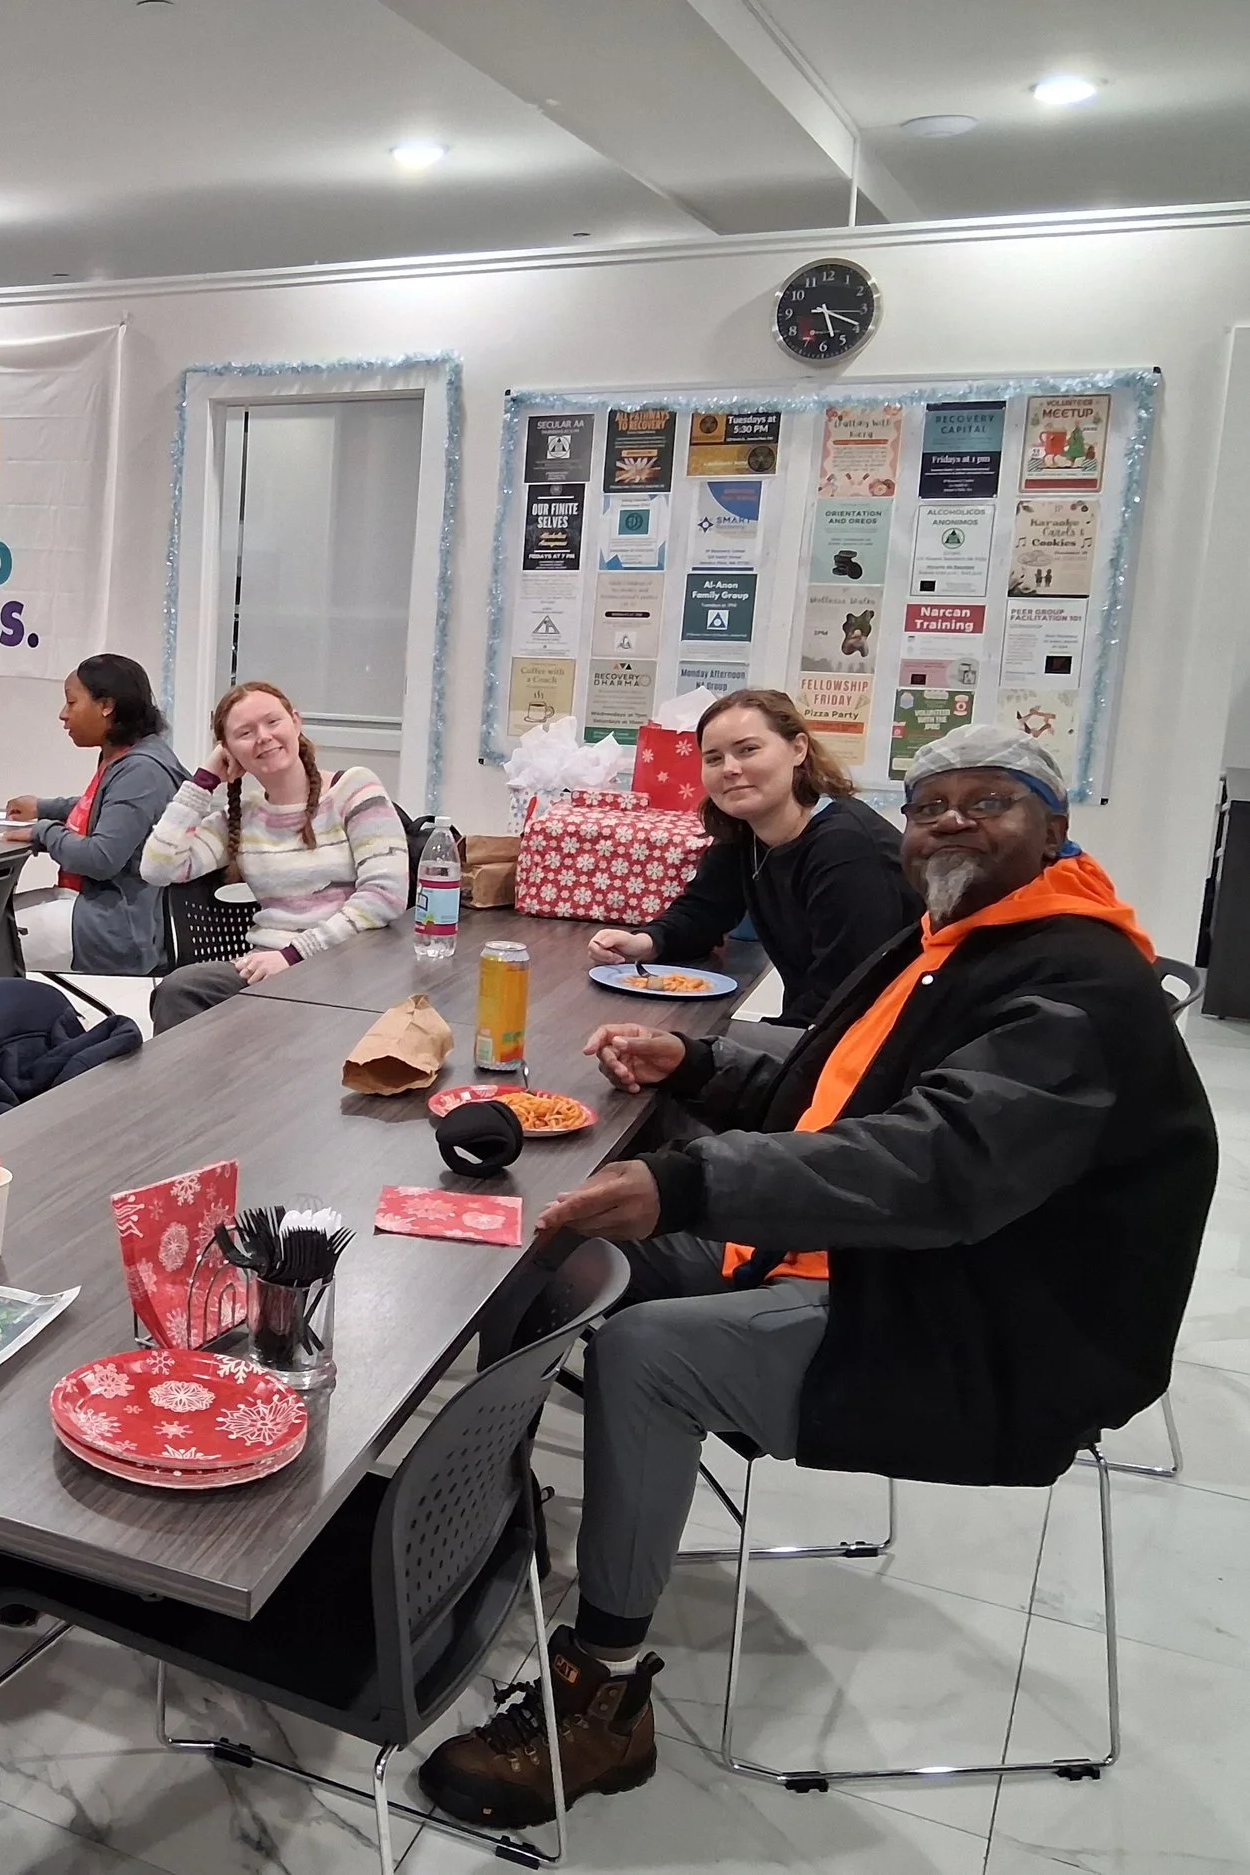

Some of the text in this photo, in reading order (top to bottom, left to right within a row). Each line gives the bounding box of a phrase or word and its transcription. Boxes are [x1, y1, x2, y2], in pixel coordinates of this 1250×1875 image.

[822, 271, 835, 281] 12
[845, 275, 850, 285] 1
[805, 277, 817, 288] 11
[791, 290, 805, 301] 10
[856, 286, 864, 296] 2
[785, 308, 793, 319] 9
[789, 325, 797, 336] 8
[802, 337, 811, 347] 7
[839, 335, 847, 345] 5
[819, 341, 828, 352] 6
[1042, 408, 1094, 418] MEETUP
[728, 415, 777, 424] Tuesdays at
[935, 414, 994, 424] RECOVERY
[537, 419, 585, 430] SECULAR AA
[618, 419, 666, 431] TO RECOVERY
[733, 424, 769, 434] 5:30 PM
[940, 425, 986, 434] CAPITAL
[932, 455, 961, 464] Fridays
[976, 456, 991, 464] pm
[532, 502, 579, 516] OUR FINITE
[537, 516, 569, 529] SELVES
[716, 516, 750, 524] SMART
[1030, 519, 1080, 527] Karaoke
[1032, 539, 1076, 547] Cookies
[703, 581, 739, 589] Al-Anon
[692, 591, 749, 601] Family Group
[920, 606, 971, 617] Narcan
[914, 619, 974, 632] Training
[520, 667, 565, 676] Coffee with
[594, 672, 640, 680] RECOVERY
[681, 668, 746, 679] Monday Afternoon
[593, 679, 639, 687] DHARMA
[706, 681, 728, 691] Group
[801, 679, 869, 692] FELLOWSHIP
[813, 694, 853, 706] FRIDAY
[804, 709, 859, 720] Pizza Party
